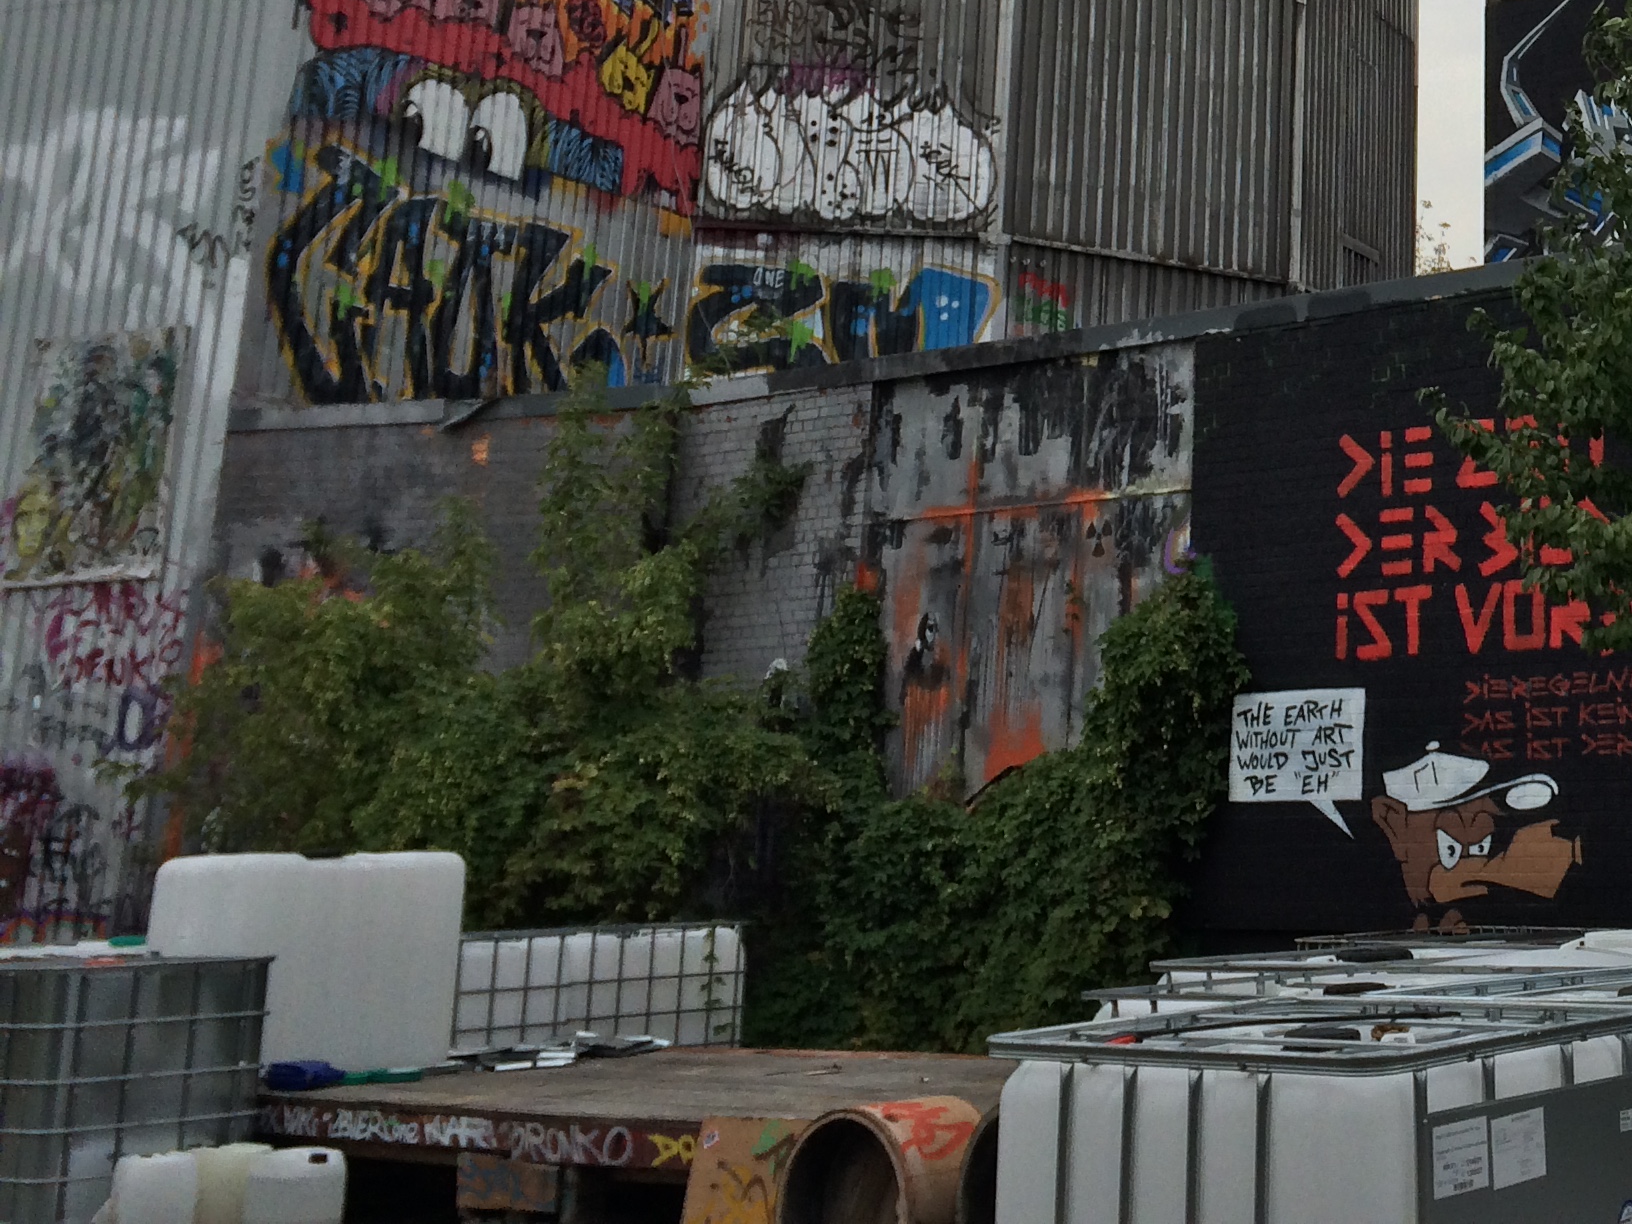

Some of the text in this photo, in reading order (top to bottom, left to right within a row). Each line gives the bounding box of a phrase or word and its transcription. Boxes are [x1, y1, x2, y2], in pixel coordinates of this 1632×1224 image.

[1236, 698, 1343, 728] THE EARTH
[1311, 722, 1354, 746] ART
[1236, 747, 1355, 772] WOULD JUST
[1243, 774, 1278, 797] BE
